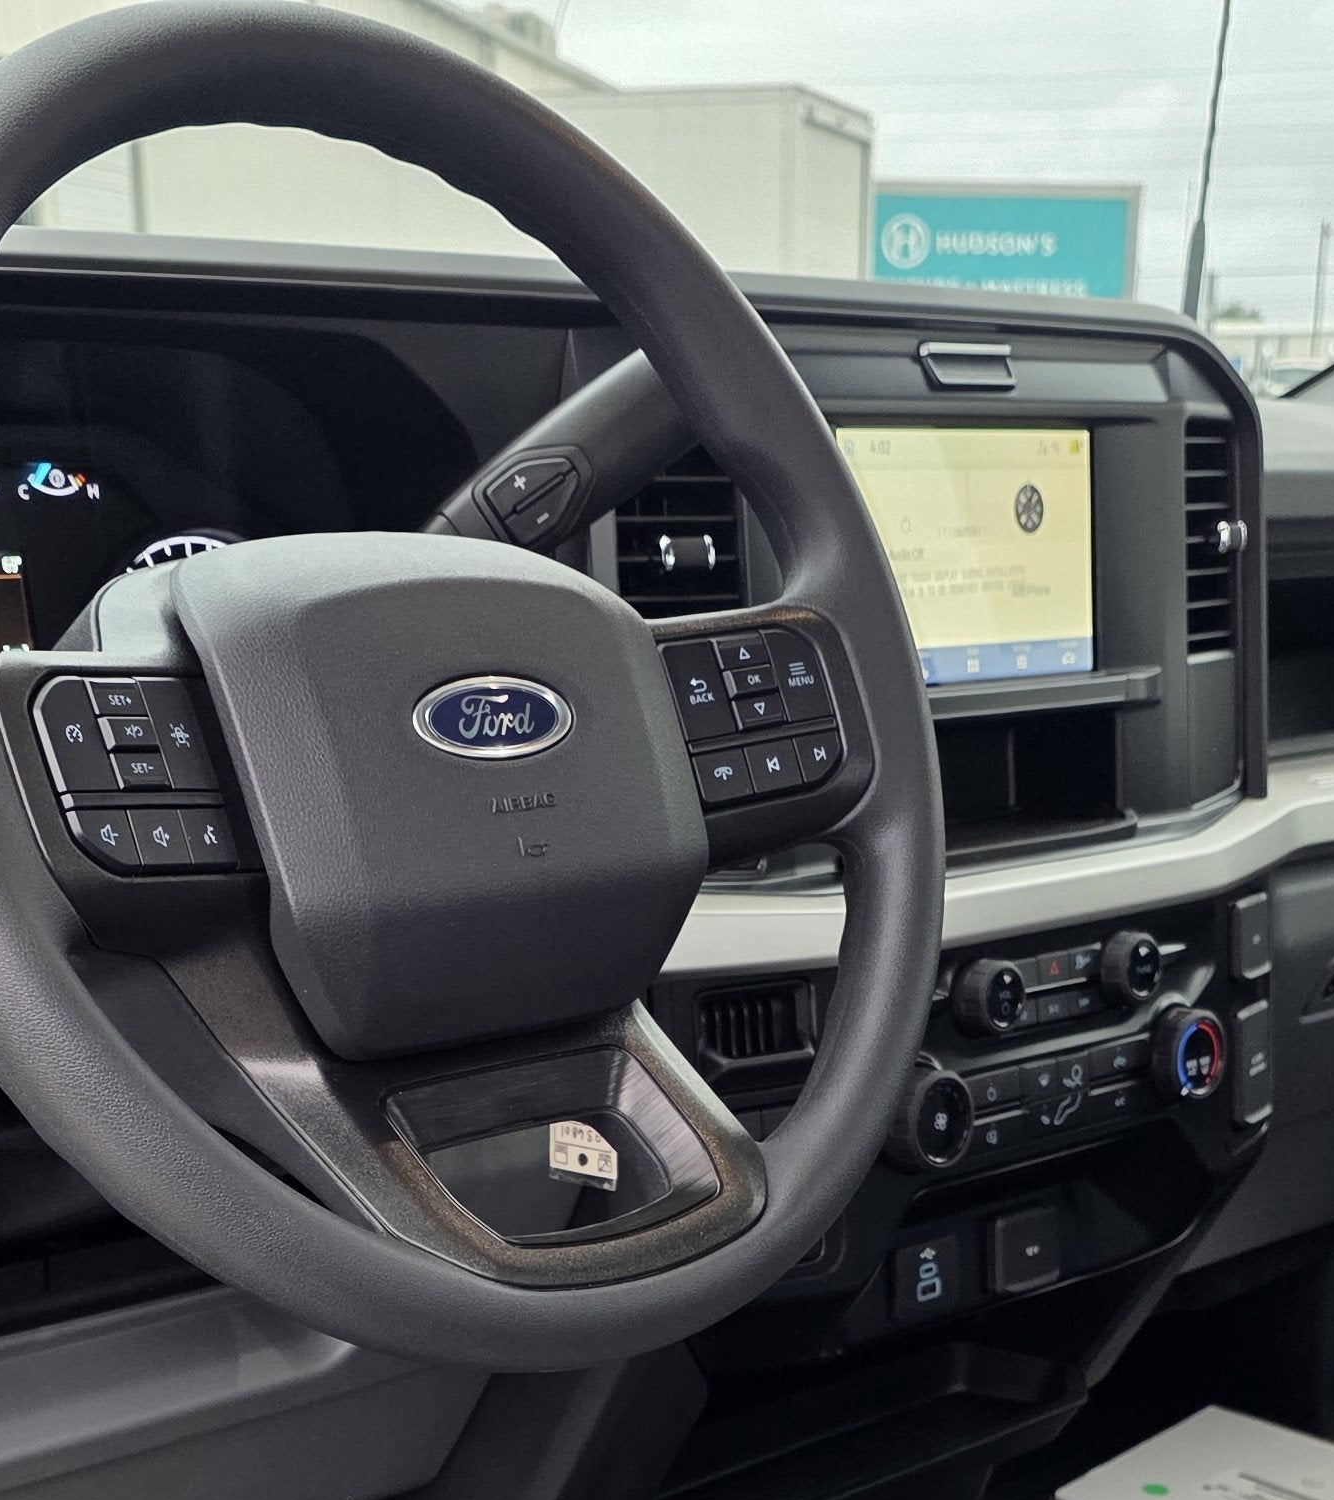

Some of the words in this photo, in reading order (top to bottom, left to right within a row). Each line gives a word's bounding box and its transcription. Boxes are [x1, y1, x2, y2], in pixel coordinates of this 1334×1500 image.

[935, 230, 1058, 257] HUDSON'S
[18, 484, 29, 500] C
[86, 483, 100, 500] H
[747, 674, 762, 686] OK
[788, 675, 814, 688] MENU
[689, 692, 715, 706] BACK
[458, 694, 535, 739] Ford
[491, 792, 556, 814] AIRBAG
